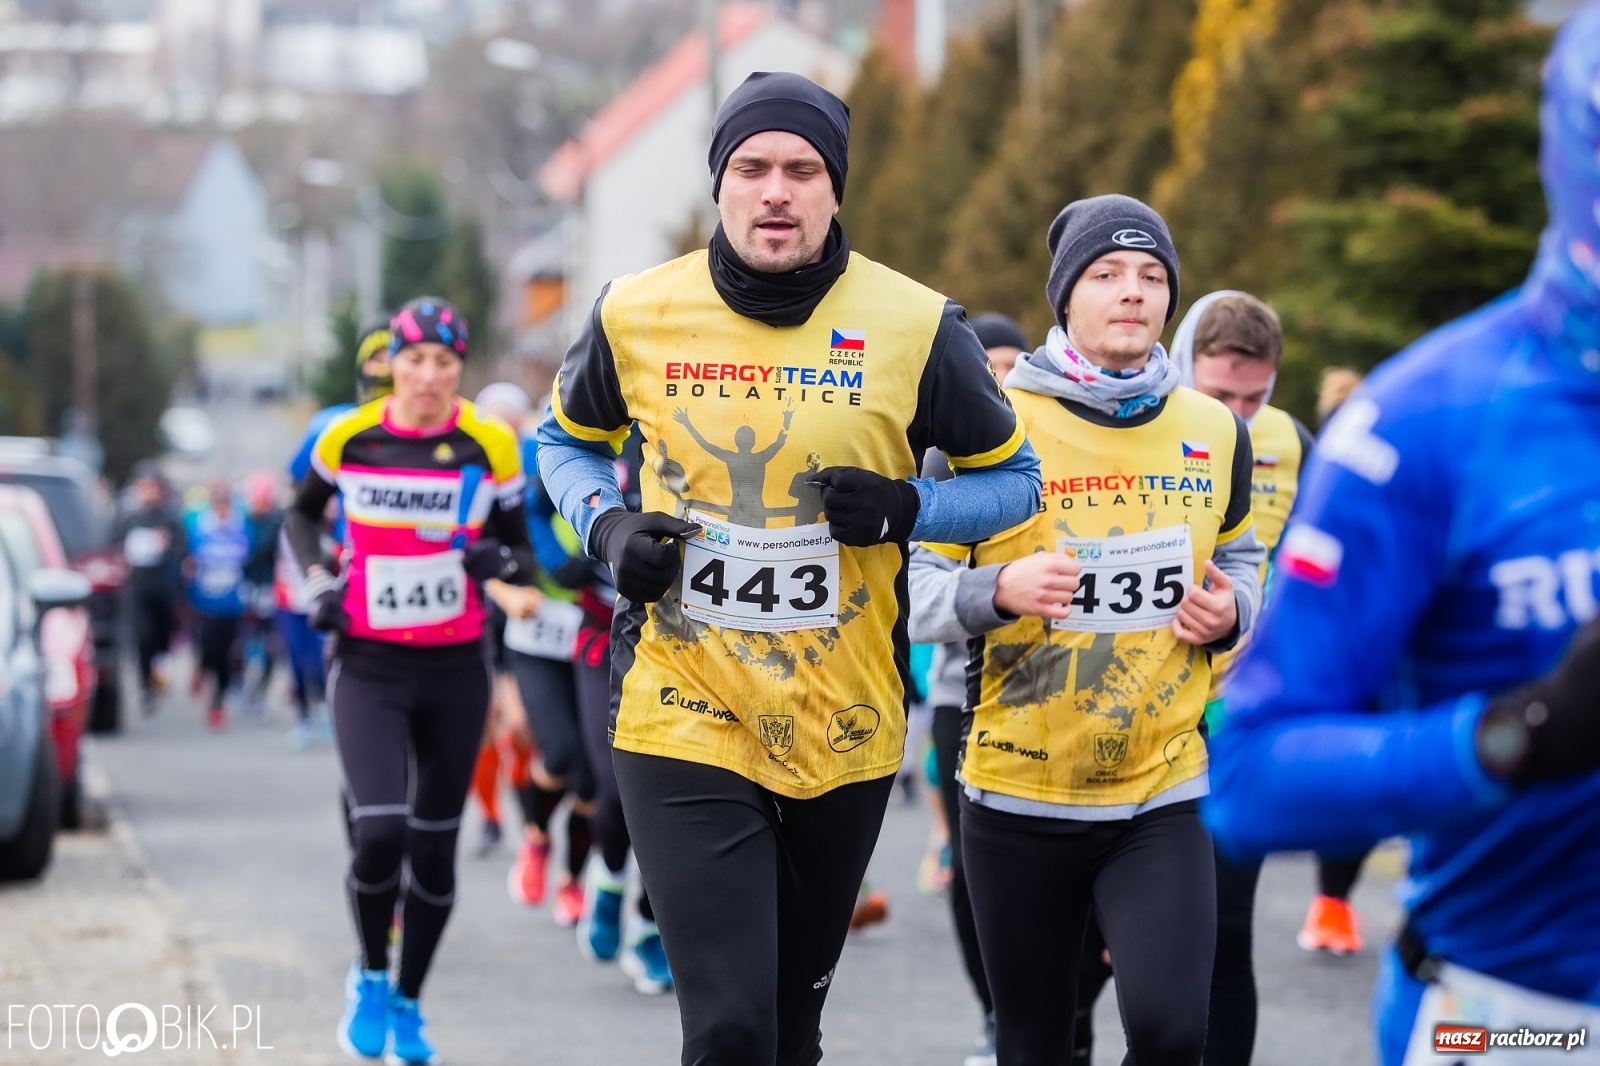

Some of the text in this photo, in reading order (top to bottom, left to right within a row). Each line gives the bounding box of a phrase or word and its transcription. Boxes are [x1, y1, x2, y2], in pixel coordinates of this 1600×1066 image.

[828, 358, 864, 367] REPUBLIC
[829, 350, 865, 359] CZECH
[666, 362, 775, 383] ENERGY
[783, 366, 863, 389] TEAM
[666, 383, 861, 406] BOLATICE
[1183, 460, 1212, 468] CZECH
[1184, 466, 1212, 475] REPUBLIC
[1144, 475, 1212, 494] TEAM
[1109, 537, 1187, 556] www.personalbest.pl
[377, 577, 458, 610] 446
[690, 558, 829, 613] 443
[1071, 565, 1184, 614] 435
[977, 730, 1049, 762] Audit-web
